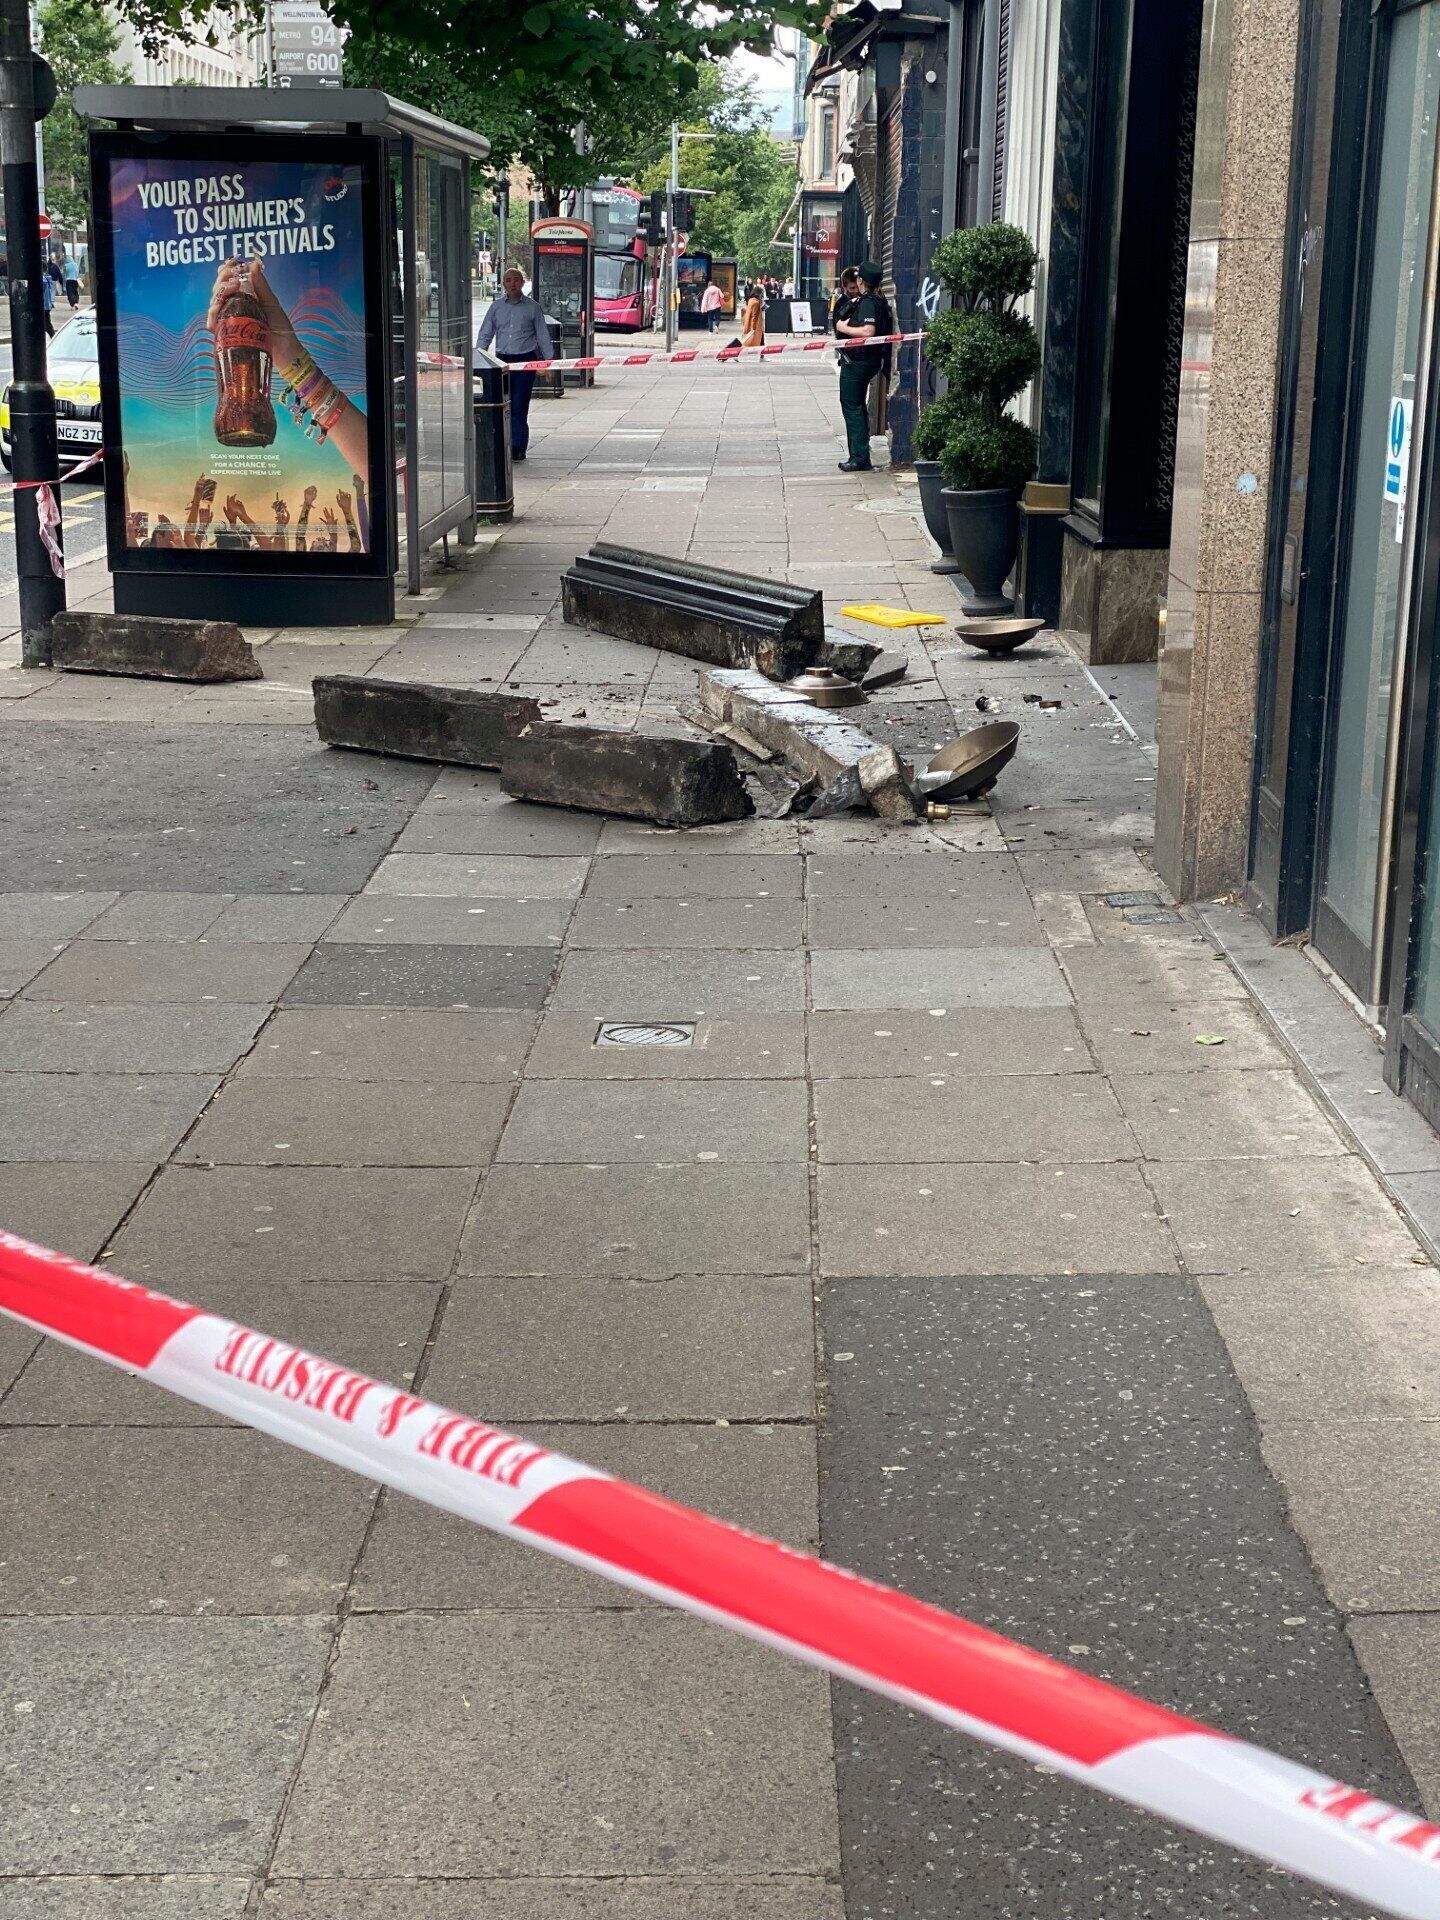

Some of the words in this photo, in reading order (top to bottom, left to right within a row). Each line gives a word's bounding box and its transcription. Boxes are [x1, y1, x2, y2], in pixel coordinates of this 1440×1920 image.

[279, 31, 301, 39] METRO
[311, 25, 336, 46] 94
[279, 52, 305, 60] AIRPORT
[307, 53, 339, 71] 600
[137, 180, 191, 210] YOUR
[194, 173, 245, 204] PASS
[174, 208, 199, 235] TO
[203, 197, 306, 232] SUMMER'S
[549, 228, 573, 236] Telephone
[146, 235, 227, 267] BIGGEST
[232, 224, 335, 258] FESTIVALS
[58, 427, 79, 439] NGZ
[214, 1328, 375, 1424] RESCUE
[377, 1394, 422, 1440] &
[418, 1414, 549, 1489] FIRE
